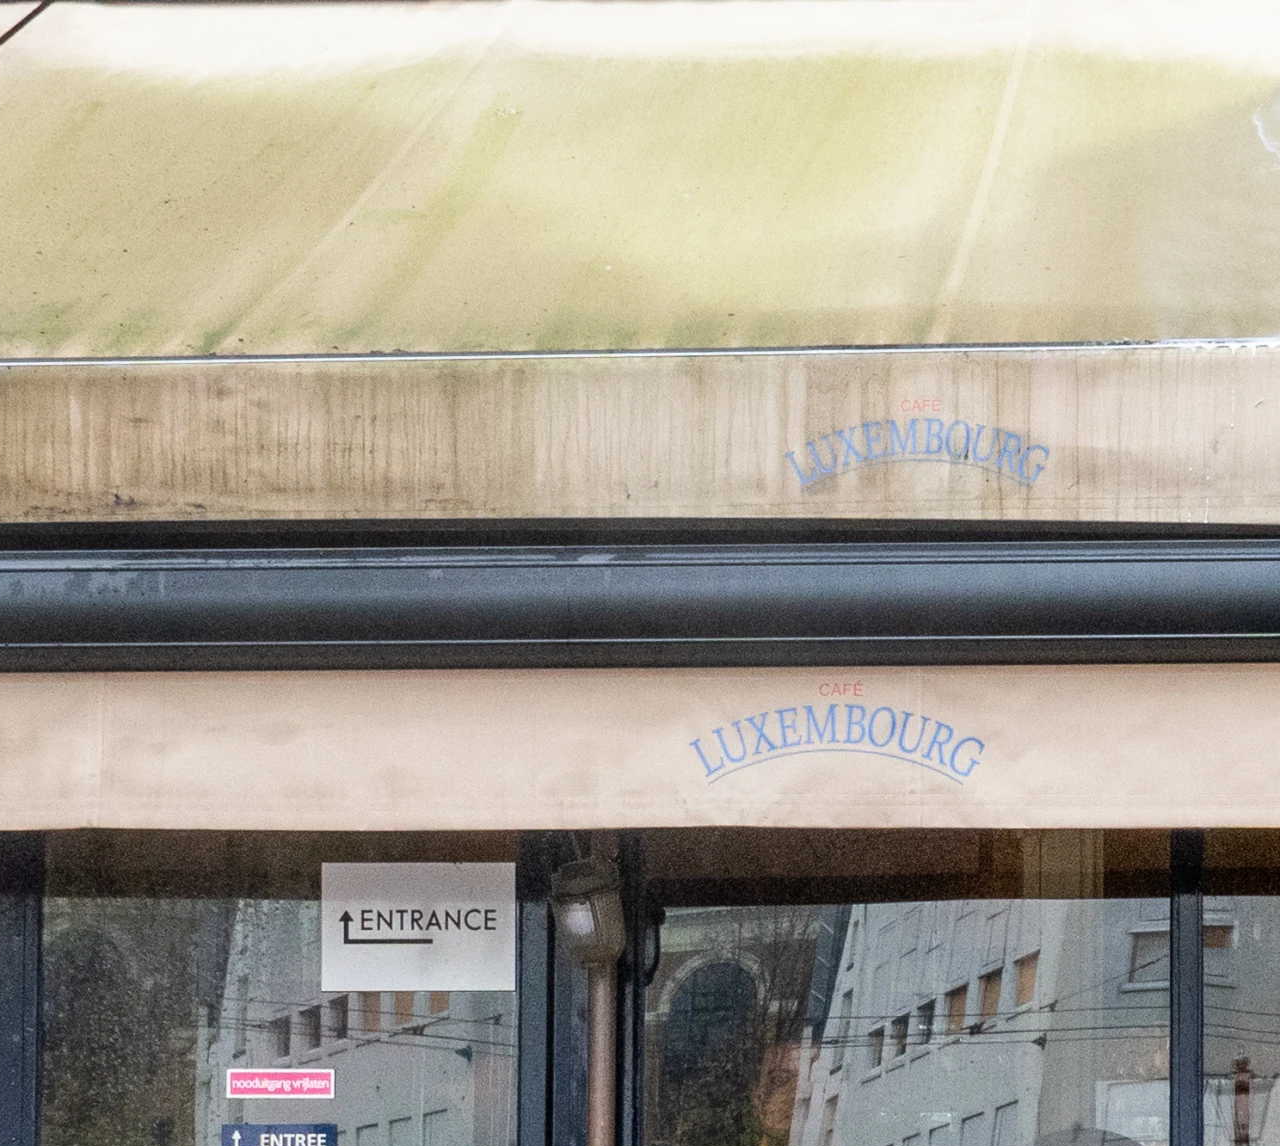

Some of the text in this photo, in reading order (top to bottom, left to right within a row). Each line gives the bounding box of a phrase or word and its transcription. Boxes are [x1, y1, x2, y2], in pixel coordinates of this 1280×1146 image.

[785, 417, 1050, 487] LUXEMBOURG
[818, 680, 864, 697] CAFÉ
[689, 703, 986, 778] LUXEMBOURG
[360, 908, 497, 931] ENTRANCE
[232, 1077, 330, 1092] nooduitgang vrijlaten
